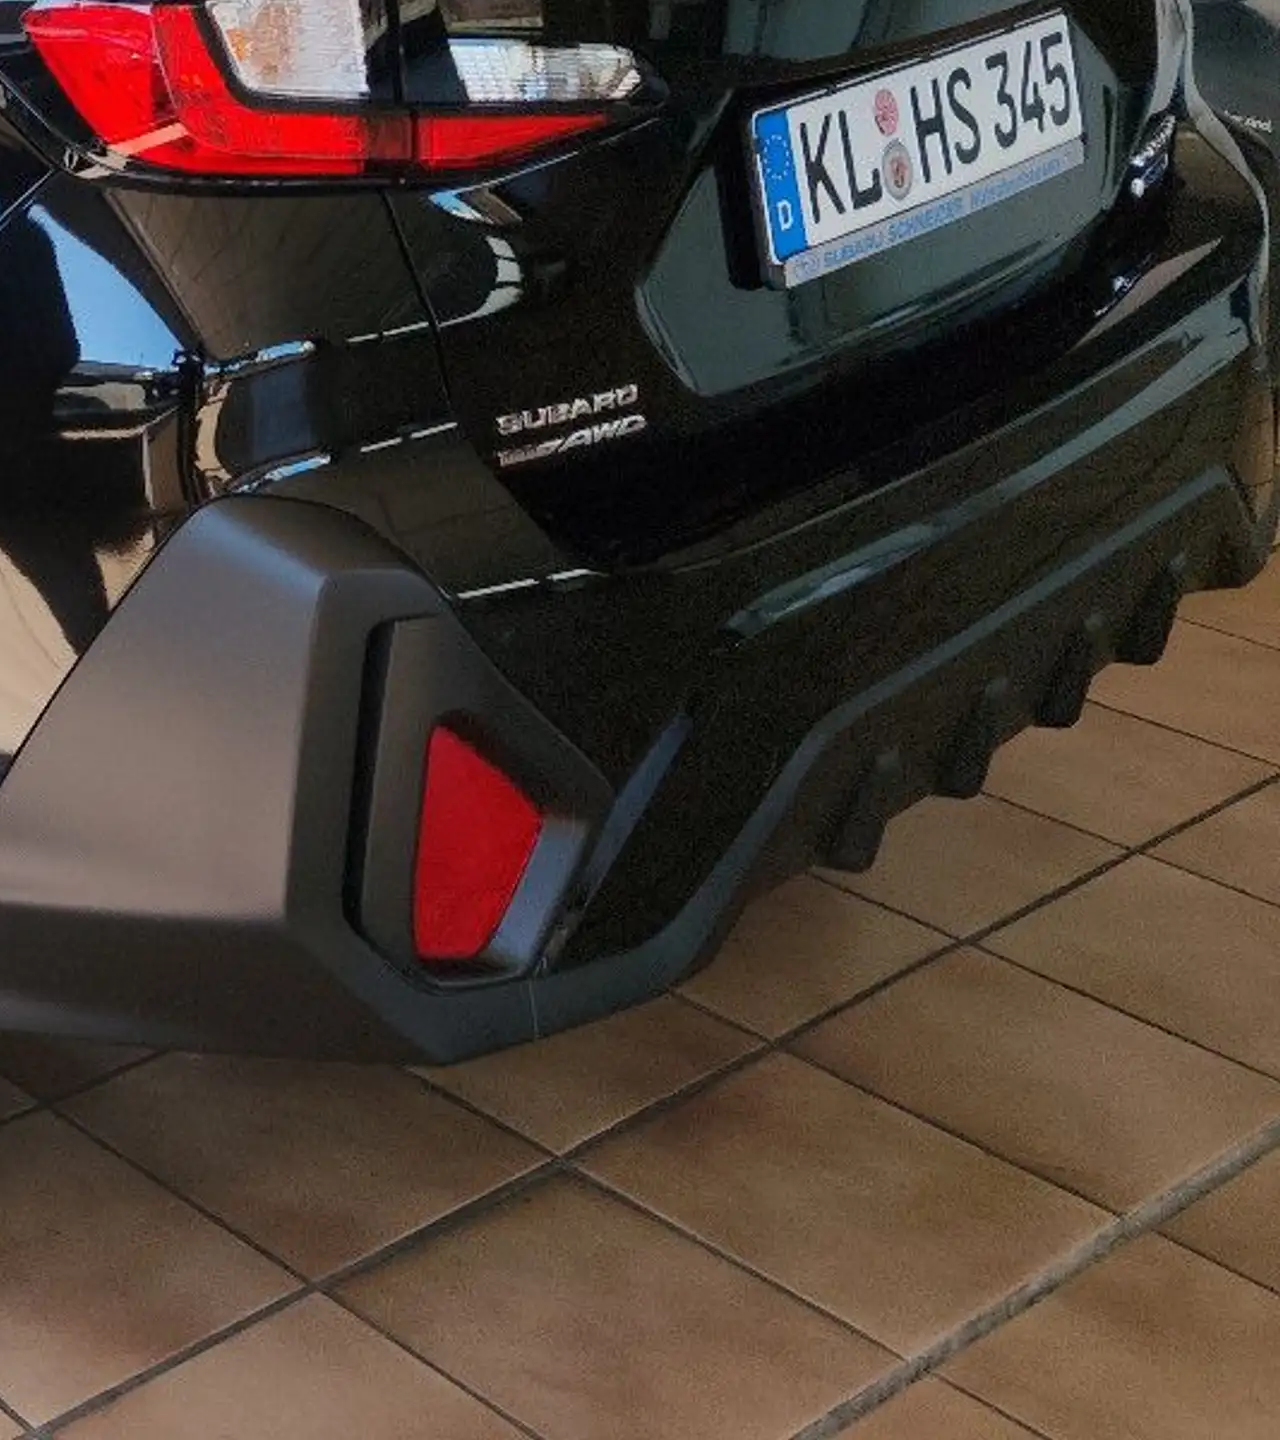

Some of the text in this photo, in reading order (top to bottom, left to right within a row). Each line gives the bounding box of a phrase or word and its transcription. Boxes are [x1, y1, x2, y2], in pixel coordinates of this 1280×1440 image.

[799, 109, 883, 225] KL
[910, 66, 982, 184] HS
[984, 31, 1071, 149] 345
[777, 199, 794, 231] D
[496, 383, 638, 436] SUBARU
[557, 414, 647, 453] AWD
